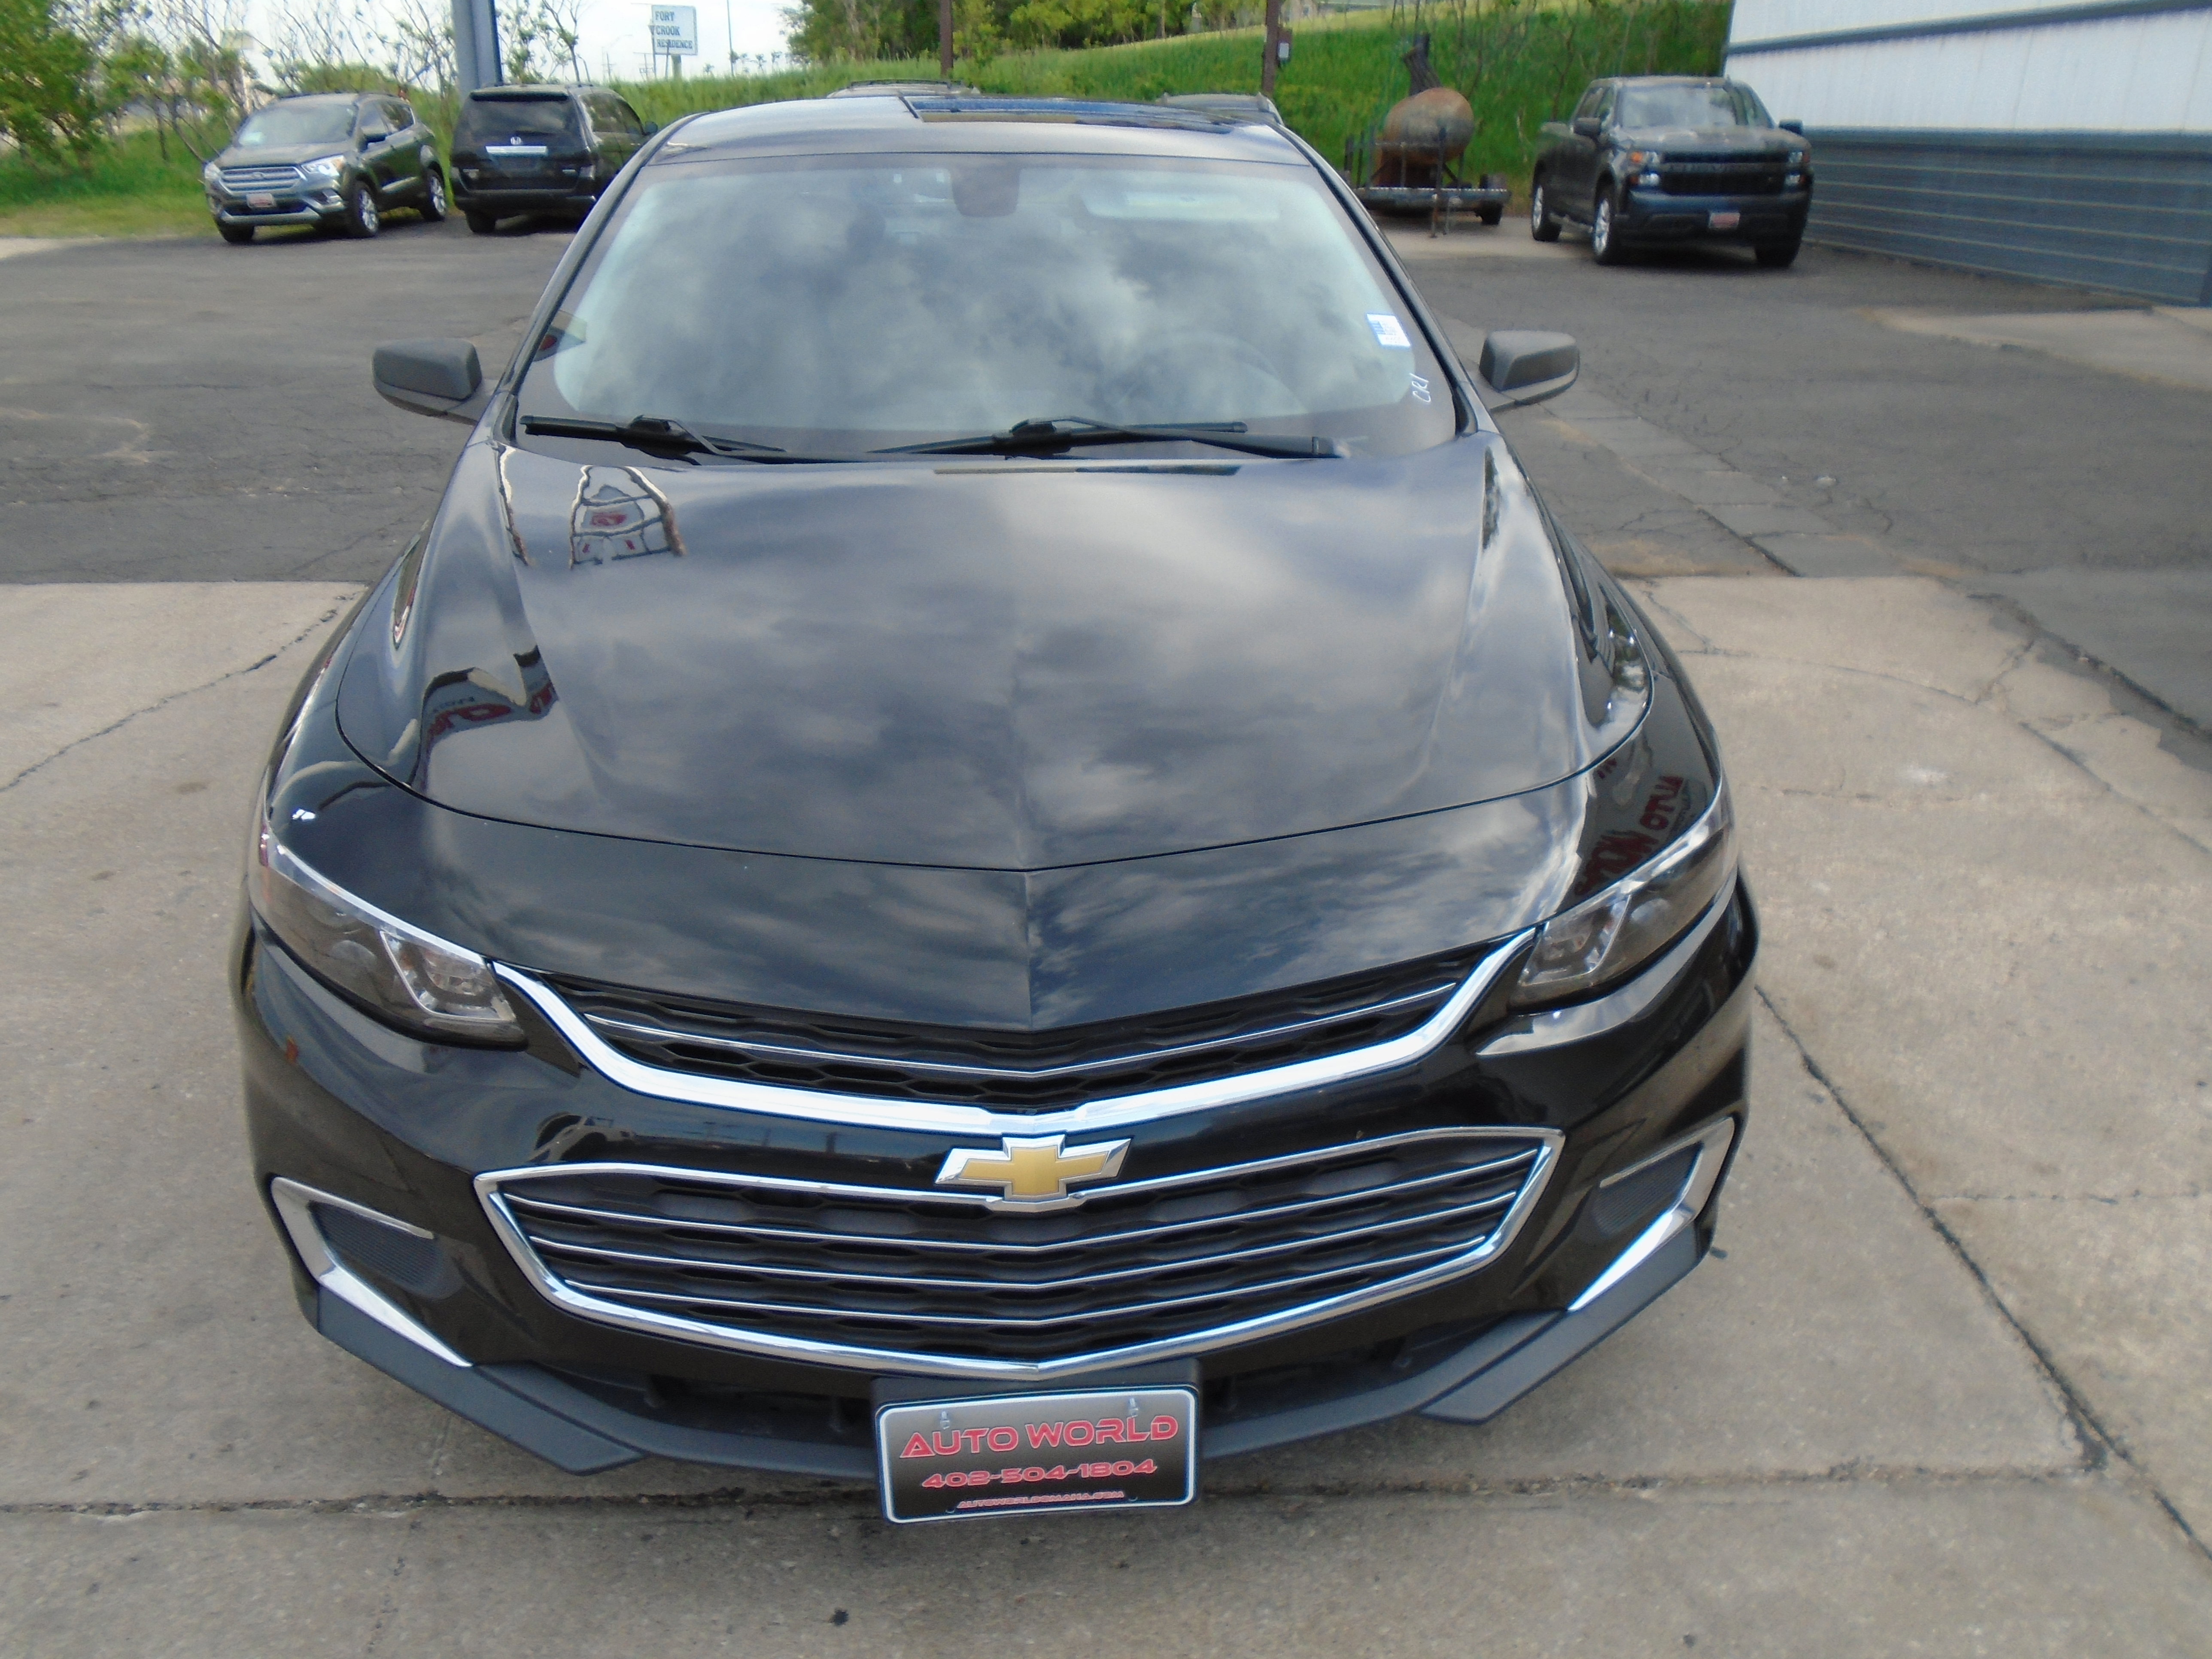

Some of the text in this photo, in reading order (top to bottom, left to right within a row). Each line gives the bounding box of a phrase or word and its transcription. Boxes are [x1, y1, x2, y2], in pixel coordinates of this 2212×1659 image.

[655, 11, 675, 21] FORT
[656, 25, 680, 36] CROOK
[657, 39, 692, 49] RESIDENCE
[899, 1415, 1179, 1458] AUTO WORLD
[921, 1458, 1158, 1488] 402-504-1804
[956, 1491, 1124, 1509] AUTOWORLDOMAHA.COM
